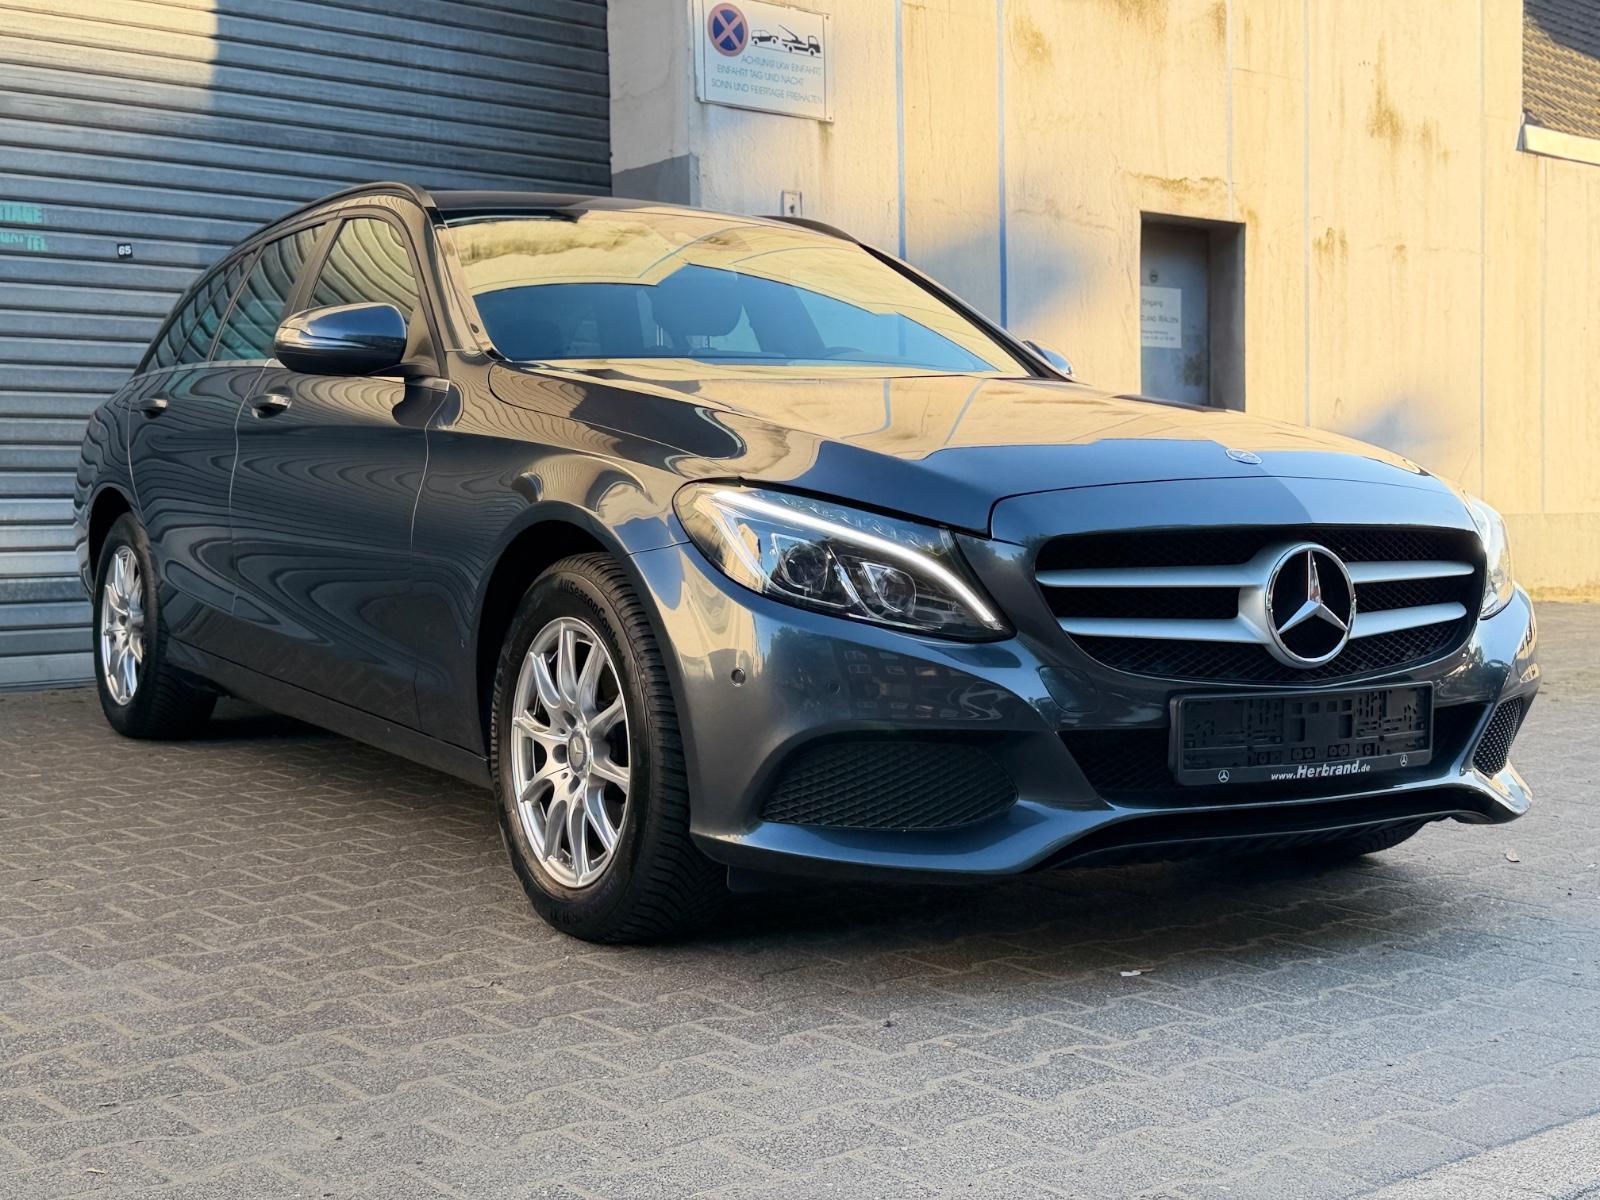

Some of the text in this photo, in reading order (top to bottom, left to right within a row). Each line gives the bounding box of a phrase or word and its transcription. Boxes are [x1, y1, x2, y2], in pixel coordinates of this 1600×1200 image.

[717, 64, 804, 87] EINFAHRT TAG UND NACHT
[711, 78, 733, 91] SONN
[734, 81, 750, 93] UND
[118, 245, 132, 255] 65
[1271, 759, 1371, 780] www.Herbrand.de
